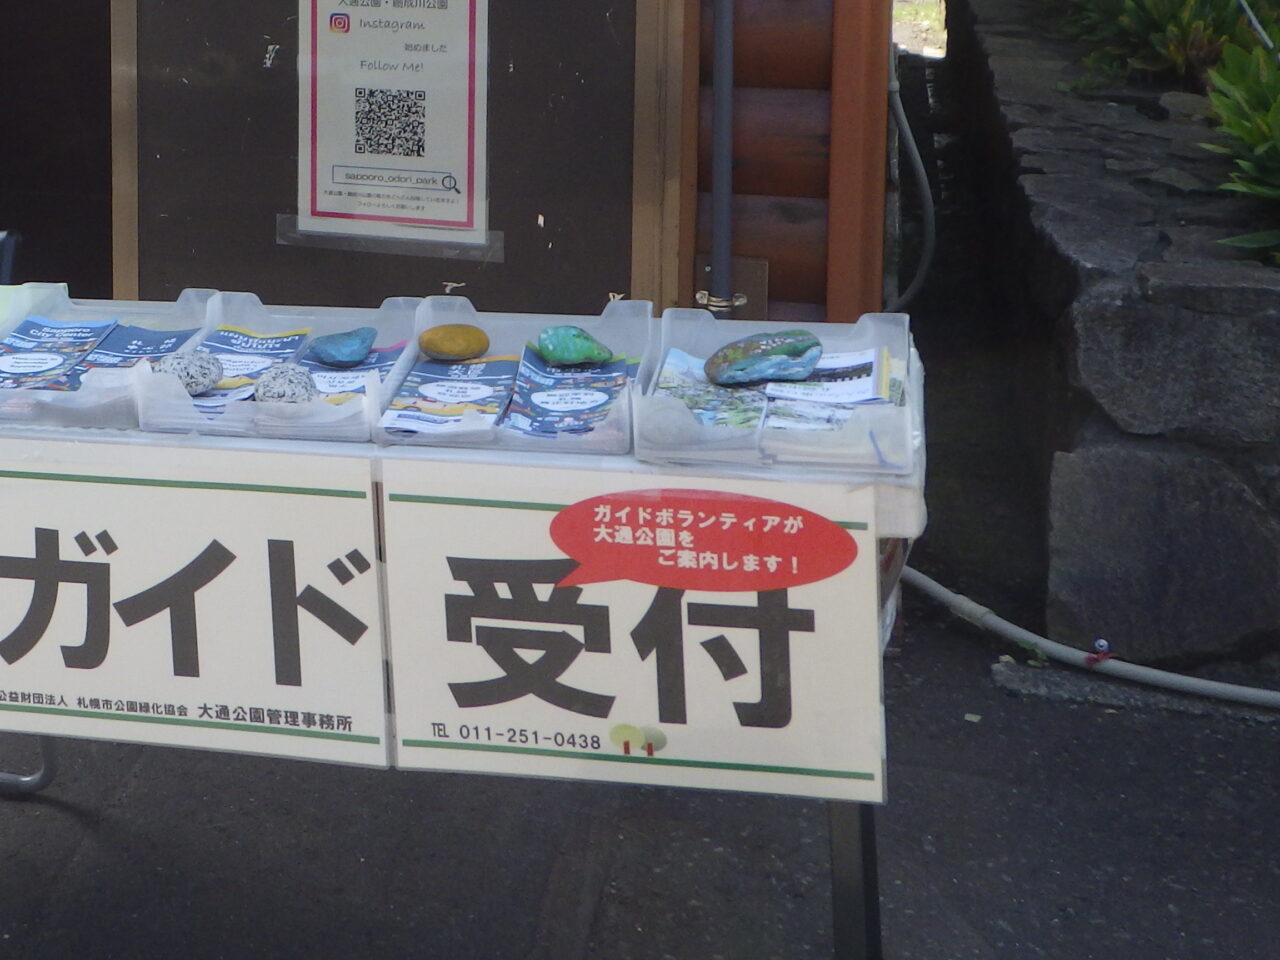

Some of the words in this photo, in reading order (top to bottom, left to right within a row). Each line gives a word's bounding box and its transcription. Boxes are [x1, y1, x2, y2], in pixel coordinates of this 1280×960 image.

[359, 18, 426, 32] Instagram
[360, 60, 399, 72] Follow
[402, 62, 424, 72] Me!
[29, 329, 54, 338] City
[55, 330, 94, 339] Center
[42, 326, 91, 334] Sapporo
[593, 504, 804, 534] ガイドボランティアが
[593, 525, 694, 549] 大通公園を
[445, 555, 815, 729] 受付
[77, 695, 188, 718] 札幌市公園緑化協会
[198, 702, 353, 733] 大通公園管理事務所
[459, 724, 601, 750] 011-251-0438
